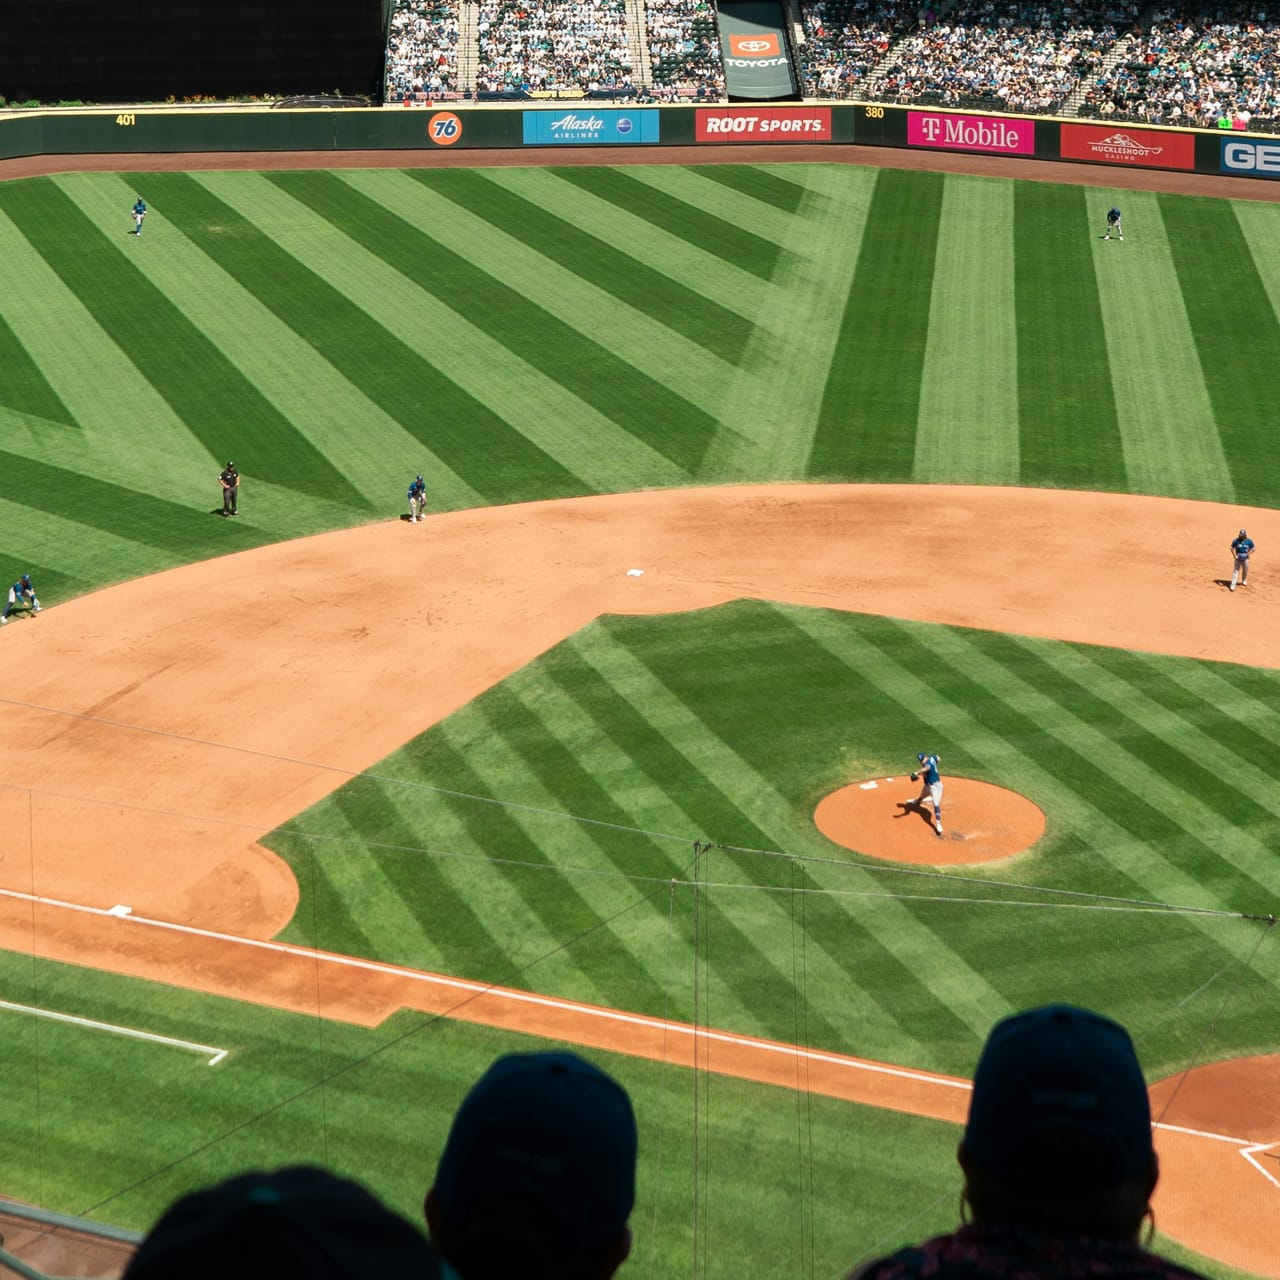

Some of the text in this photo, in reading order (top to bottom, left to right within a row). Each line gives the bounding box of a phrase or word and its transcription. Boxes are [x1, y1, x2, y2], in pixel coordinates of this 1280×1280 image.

[725, 58, 789, 68] TOYOTA
[865, 107, 885, 118] 380
[435, 118, 457, 138] 76
[550, 114, 605, 130] Alaska
[707, 117, 823, 133] ROOT SPORTS
[554, 131, 600, 139] AIRLINES
[943, 119, 1019, 149] Mobile
[1091, 145, 1150, 157] MUCKLESHOOT
[1105, 153, 1136, 161] CASINO
